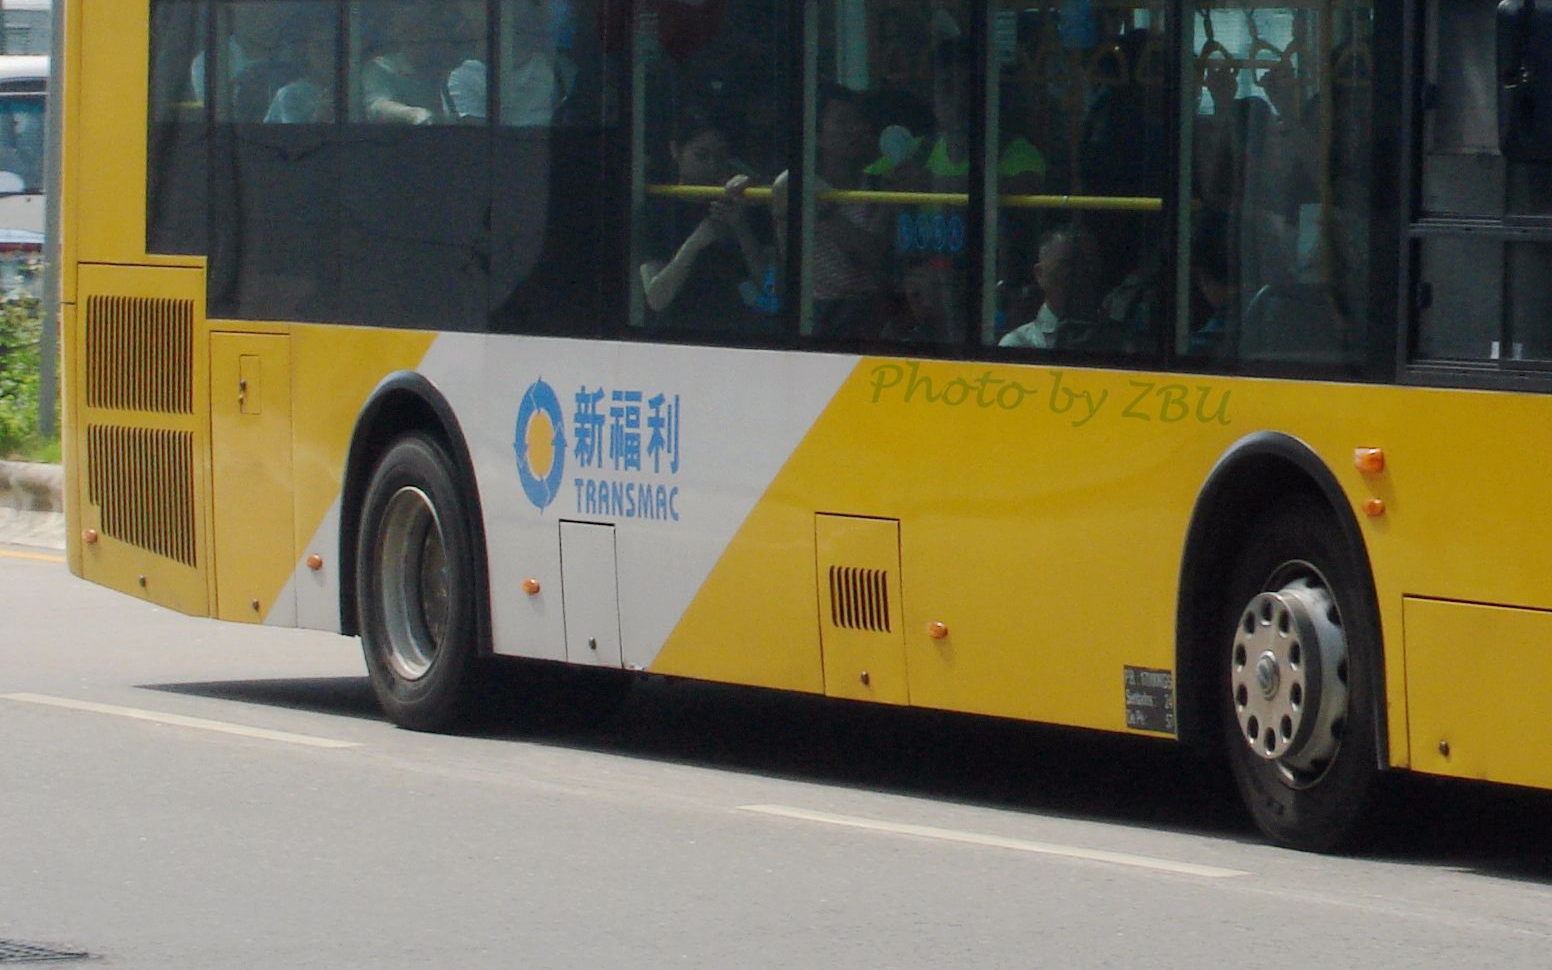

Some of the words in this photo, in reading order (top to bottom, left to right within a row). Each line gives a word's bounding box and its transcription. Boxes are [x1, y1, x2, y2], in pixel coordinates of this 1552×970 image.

[573, 384, 681, 474] 新福利
[573, 477, 680, 521] TRANSMAC
